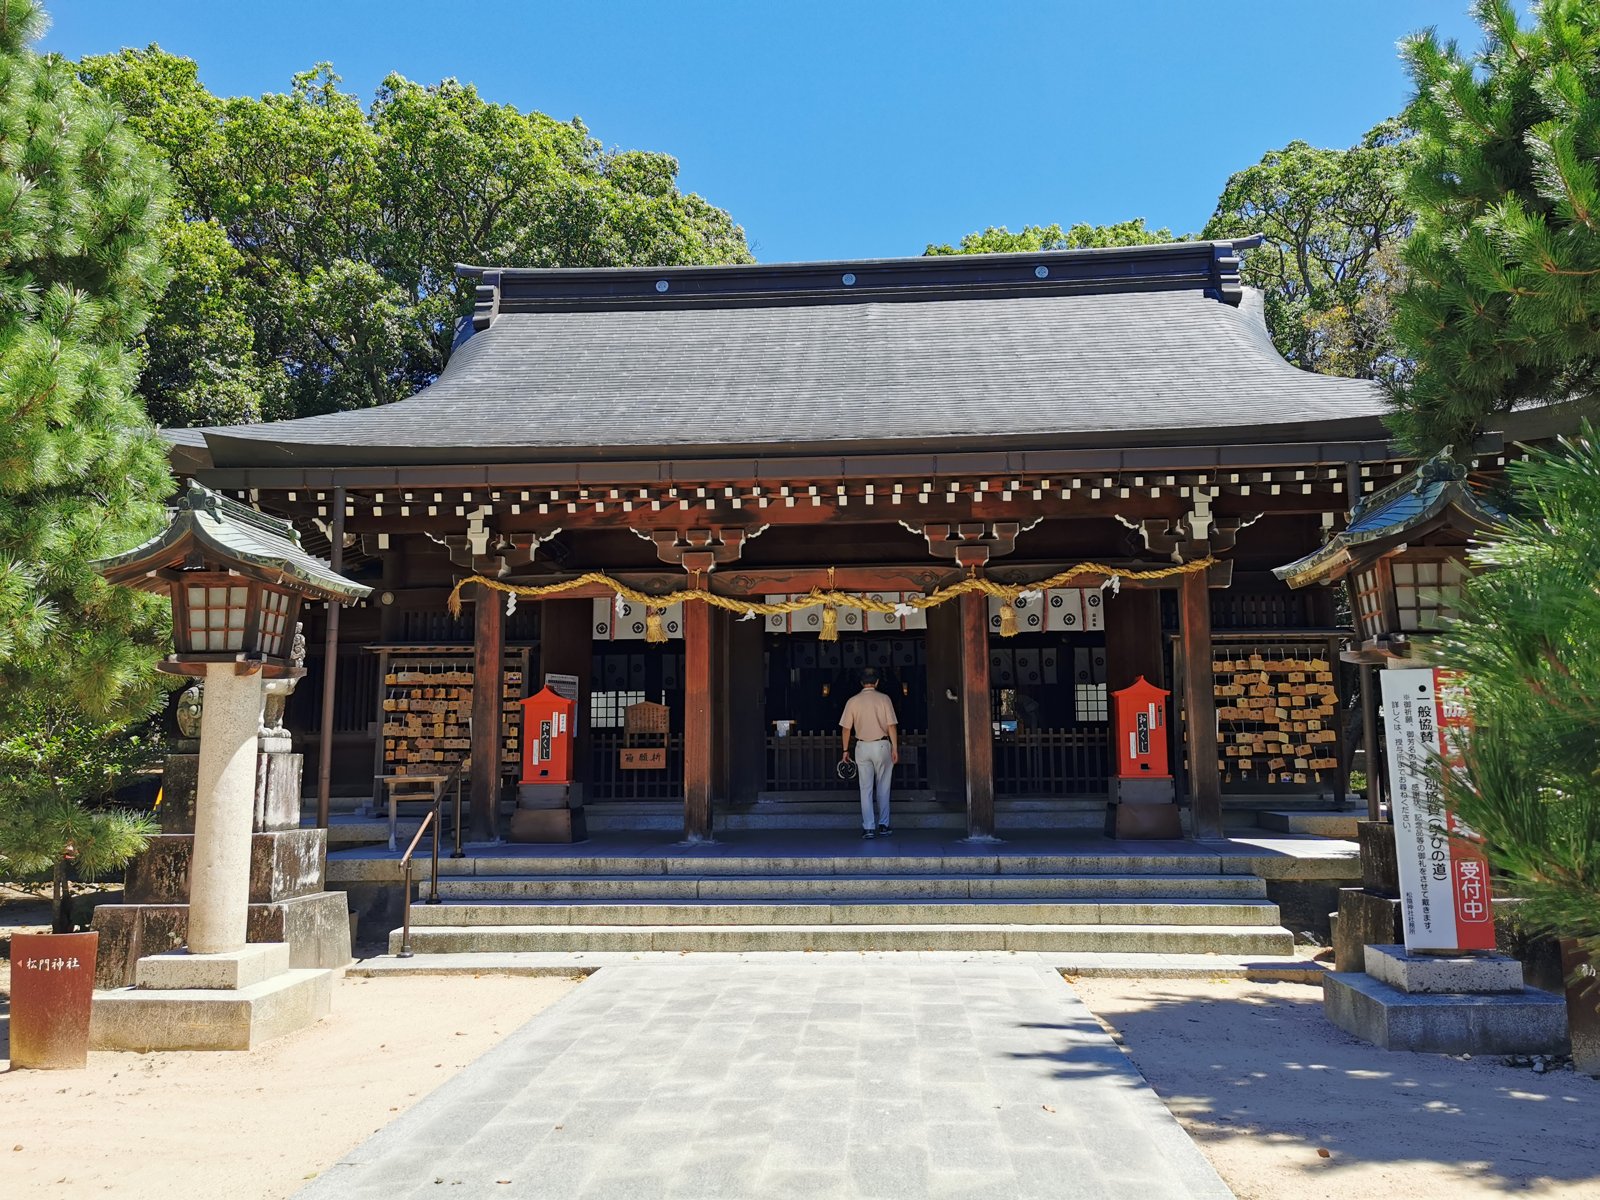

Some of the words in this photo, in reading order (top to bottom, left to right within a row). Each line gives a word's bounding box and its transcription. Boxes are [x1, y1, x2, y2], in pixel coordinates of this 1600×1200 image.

[542, 722, 550, 759] おみくじ
[1139, 714, 1148, 752] おみくじ
[1460, 861, 1483, 918] 受付中
[26, 957, 80, 971] 松門神社
